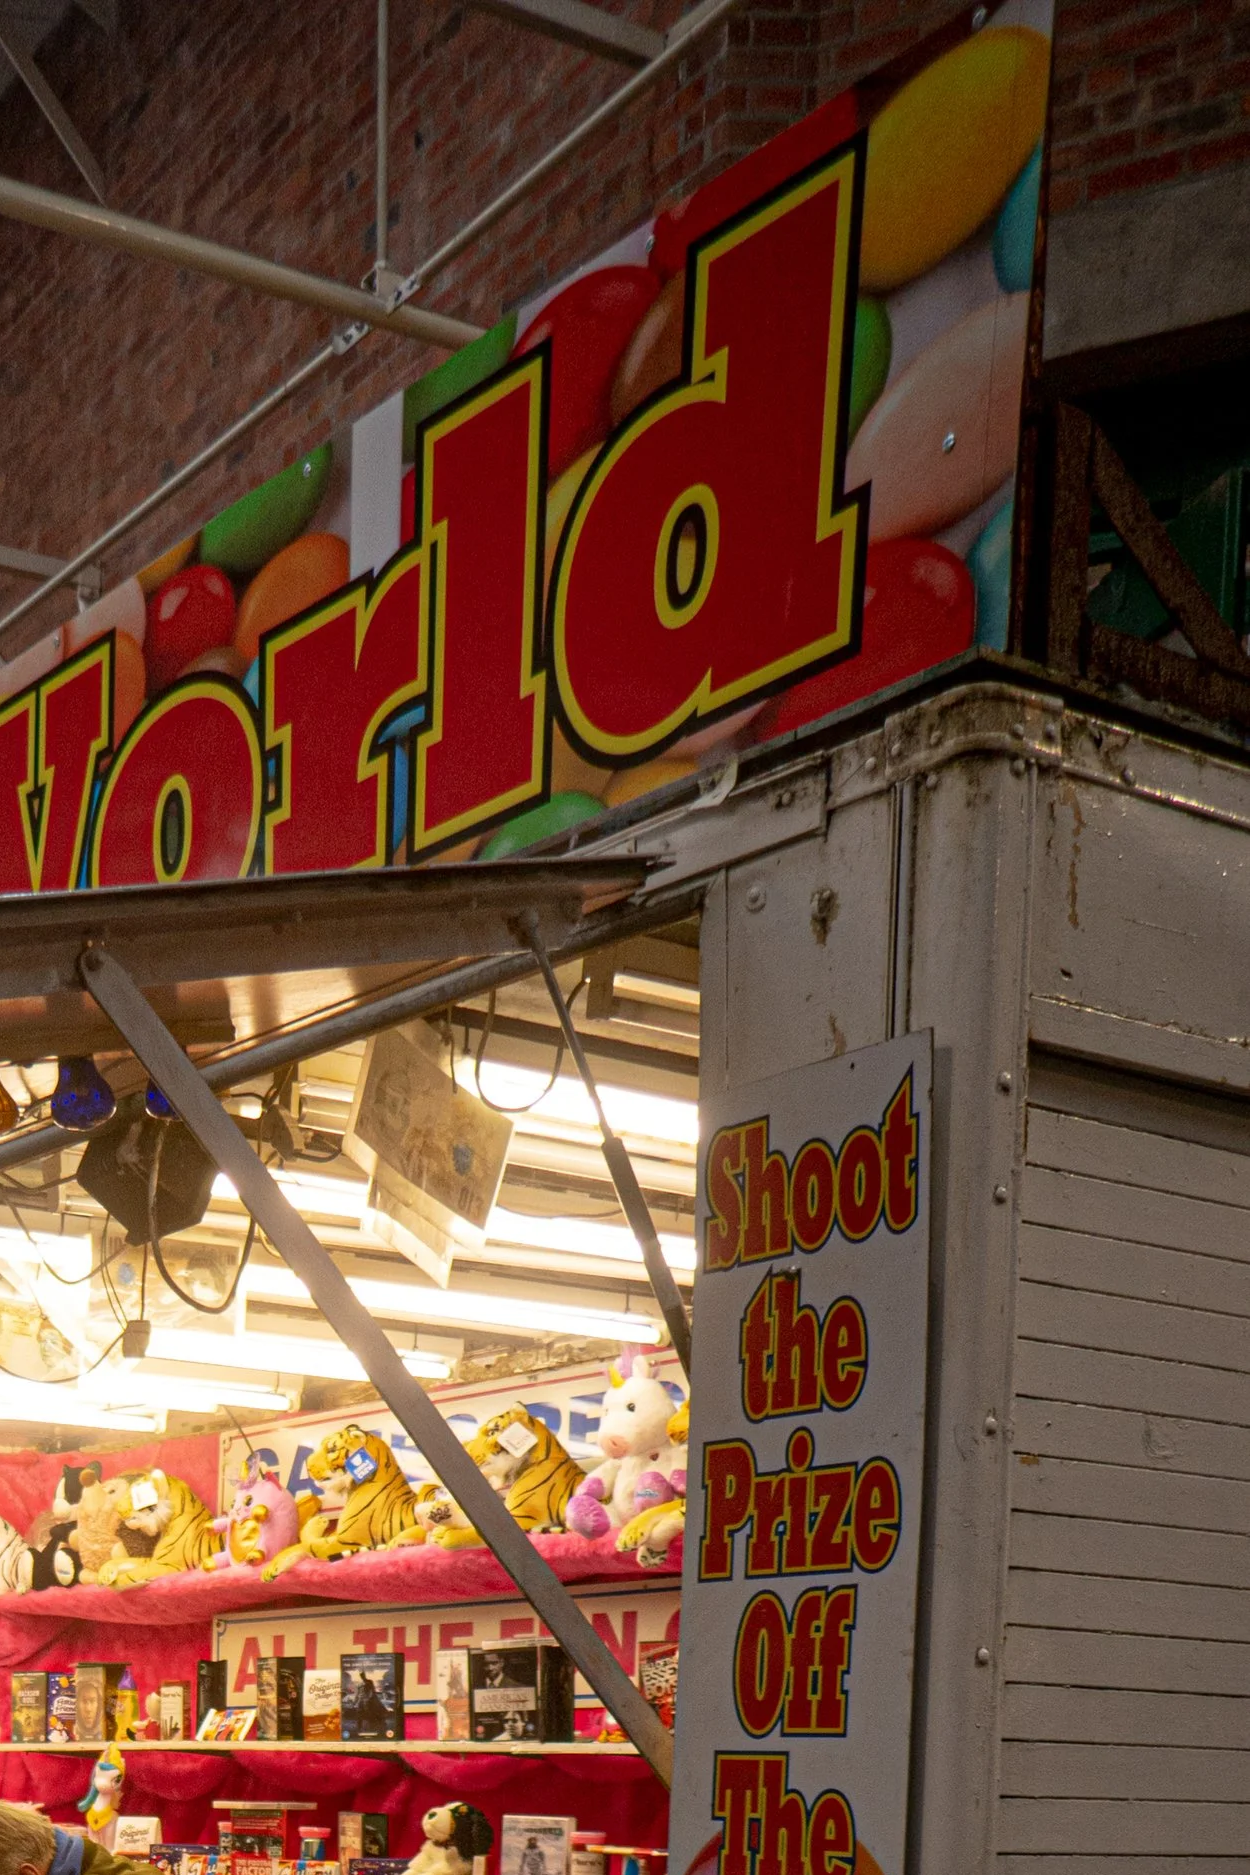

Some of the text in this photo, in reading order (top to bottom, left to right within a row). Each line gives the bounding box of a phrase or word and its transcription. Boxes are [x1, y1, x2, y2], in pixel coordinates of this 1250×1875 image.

[703, 1061, 920, 1272] Shoot
[739, 1265, 867, 1422] the
[698, 1426, 901, 1582] Prize
[734, 1584, 858, 1738] Off
